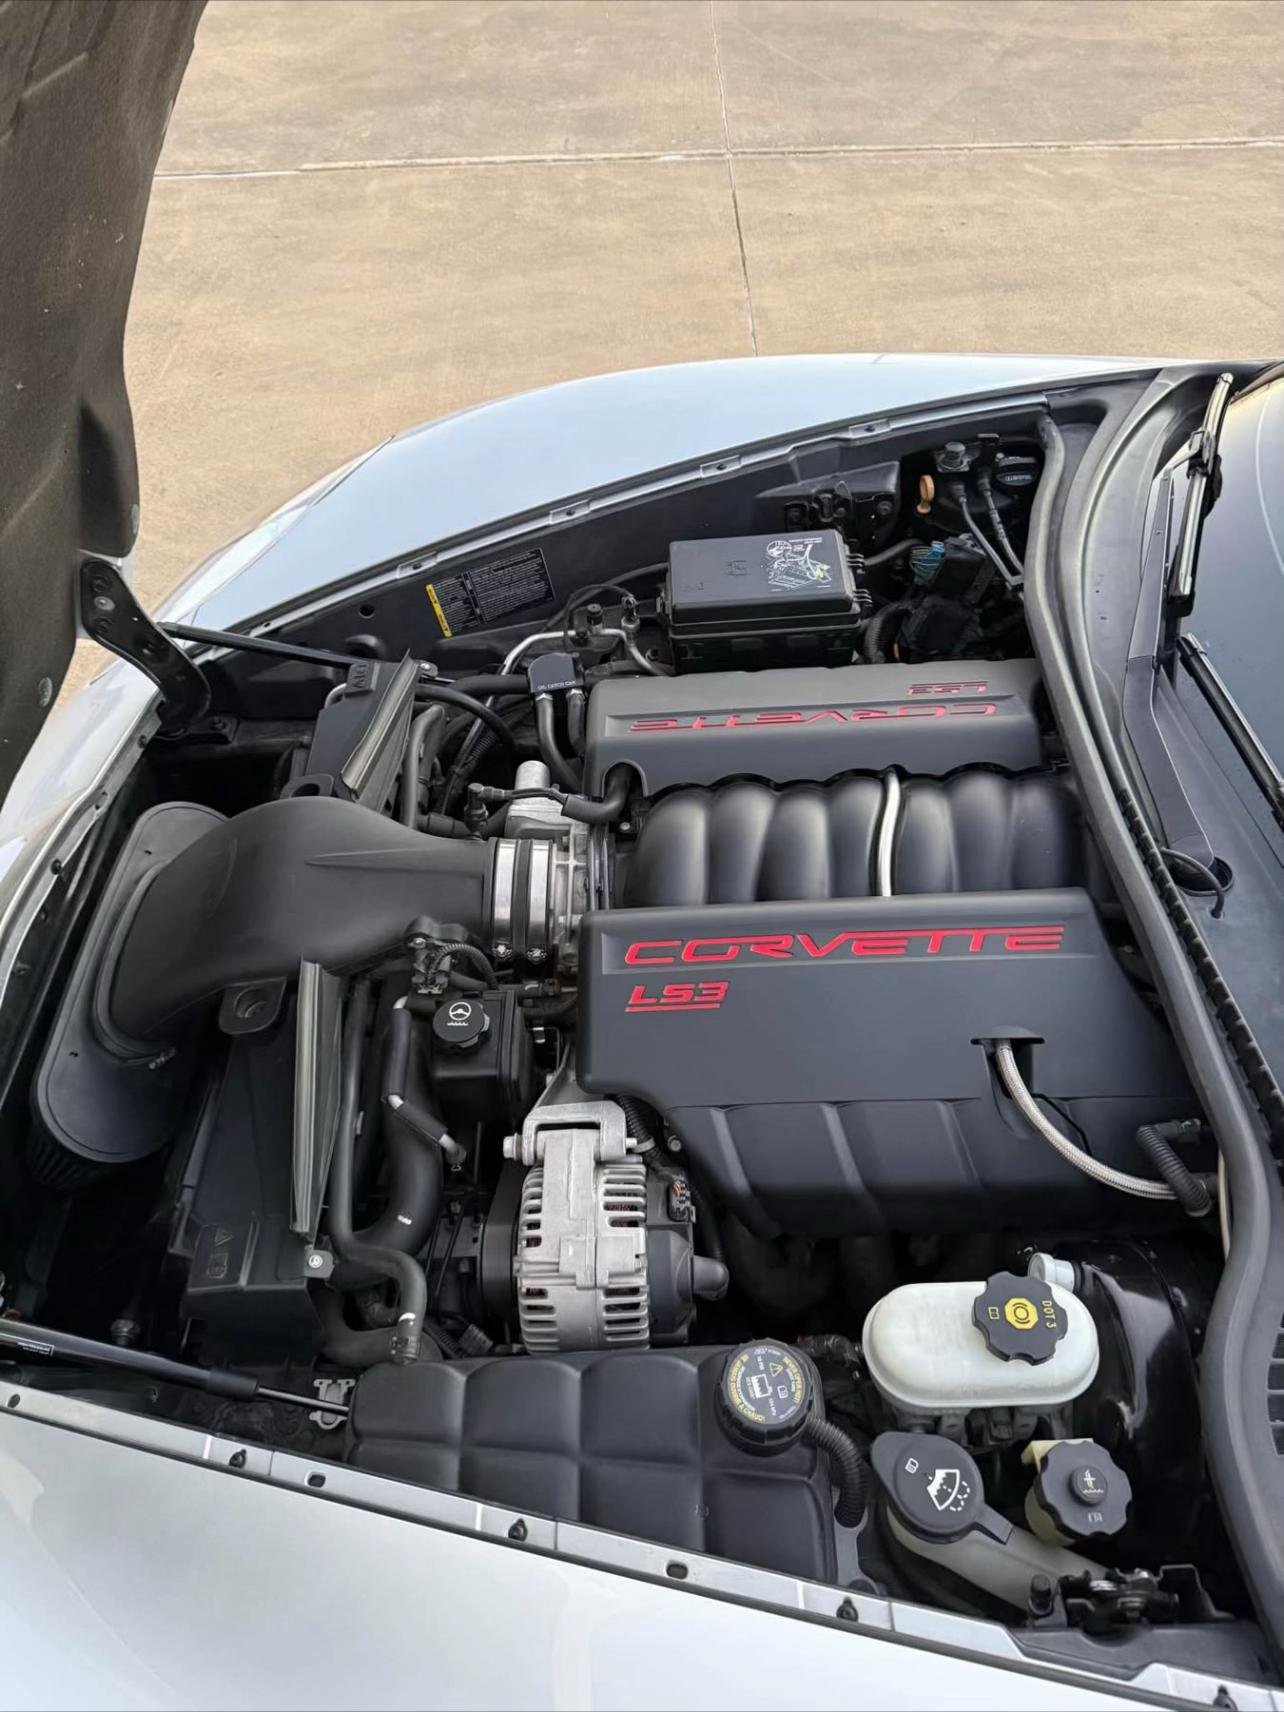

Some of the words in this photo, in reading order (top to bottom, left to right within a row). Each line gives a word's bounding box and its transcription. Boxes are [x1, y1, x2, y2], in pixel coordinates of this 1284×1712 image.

[906, 681, 989, 695] LS3
[627, 703, 997, 734] CORVETTE
[624, 925, 1065, 964] CORVETTE
[626, 981, 729, 1011] LS3
[1042, 1300, 1056, 1320] DOT
[1046, 1321, 1057, 1329] 3
